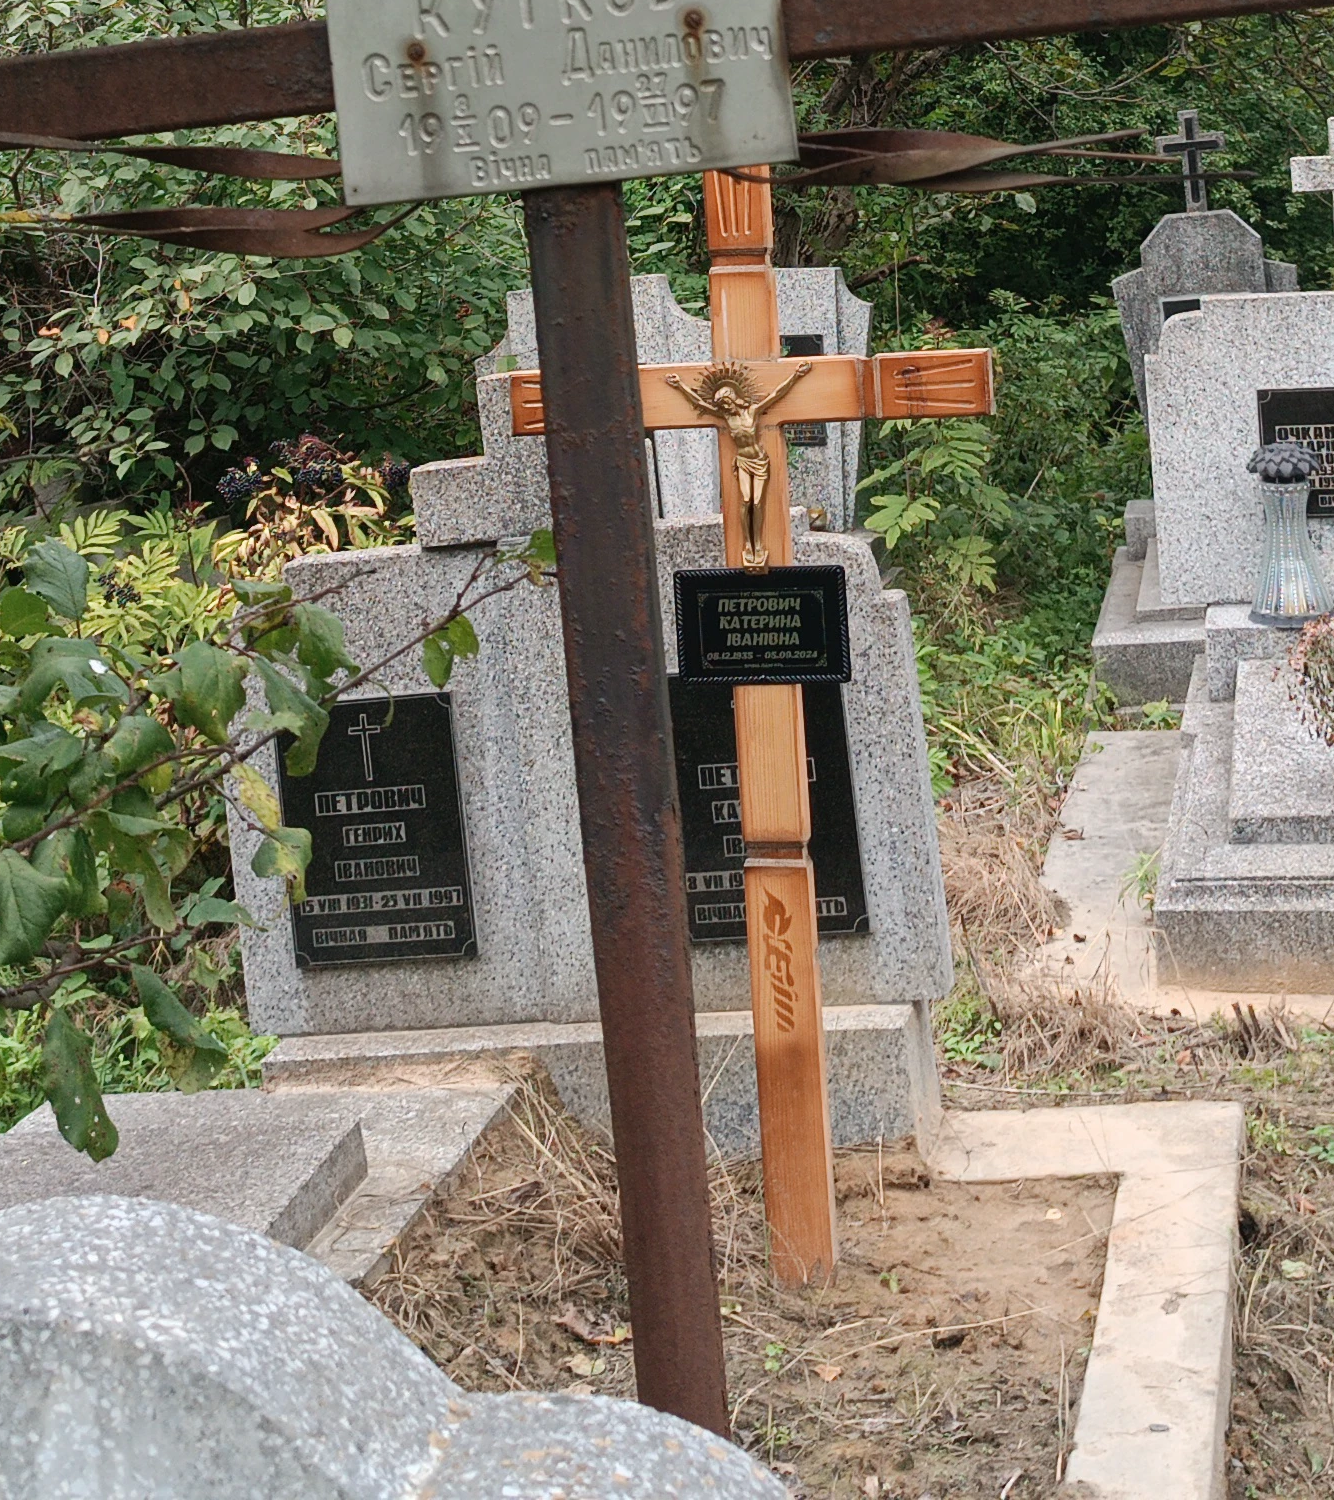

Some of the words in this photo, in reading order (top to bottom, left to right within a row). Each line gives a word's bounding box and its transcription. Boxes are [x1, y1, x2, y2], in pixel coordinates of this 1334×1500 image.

[717, 597, 801, 613] ПЕТРОВИЧ
[719, 614, 801, 629] КАТЕРИНА
[727, 631, 799, 646] ІВАНІВНА
[317, 786, 425, 814] ПЕТРОВИЧ
[344, 823, 405, 845] ГЕНРИХ
[336, 856, 418, 880] ІВАНОВИЧ
